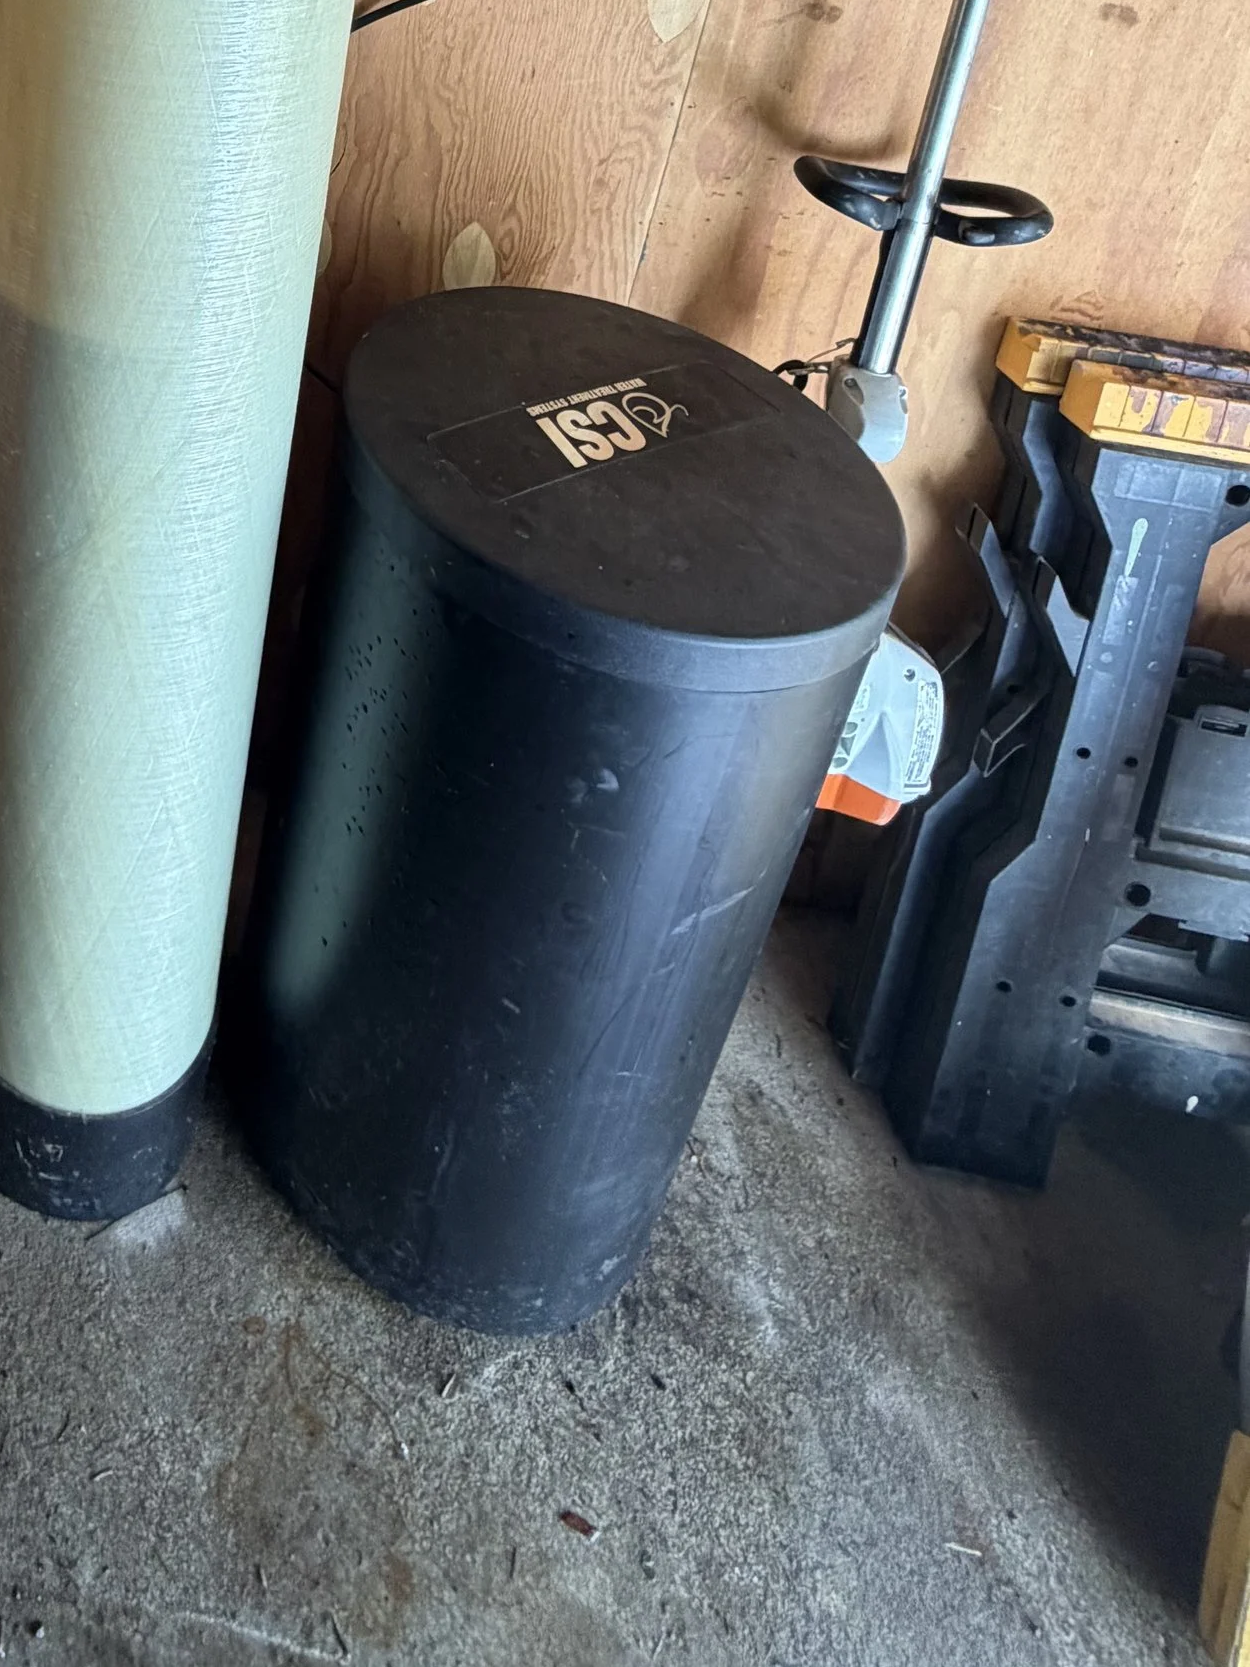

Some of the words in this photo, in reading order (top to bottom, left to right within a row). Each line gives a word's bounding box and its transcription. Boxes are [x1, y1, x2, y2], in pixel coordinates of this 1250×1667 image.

[567, 384, 618, 405] TREATMENT
[616, 377, 648, 393] WATER
[526, 397, 569, 417] SYSTEMS
[536, 401, 647, 468] CSI
